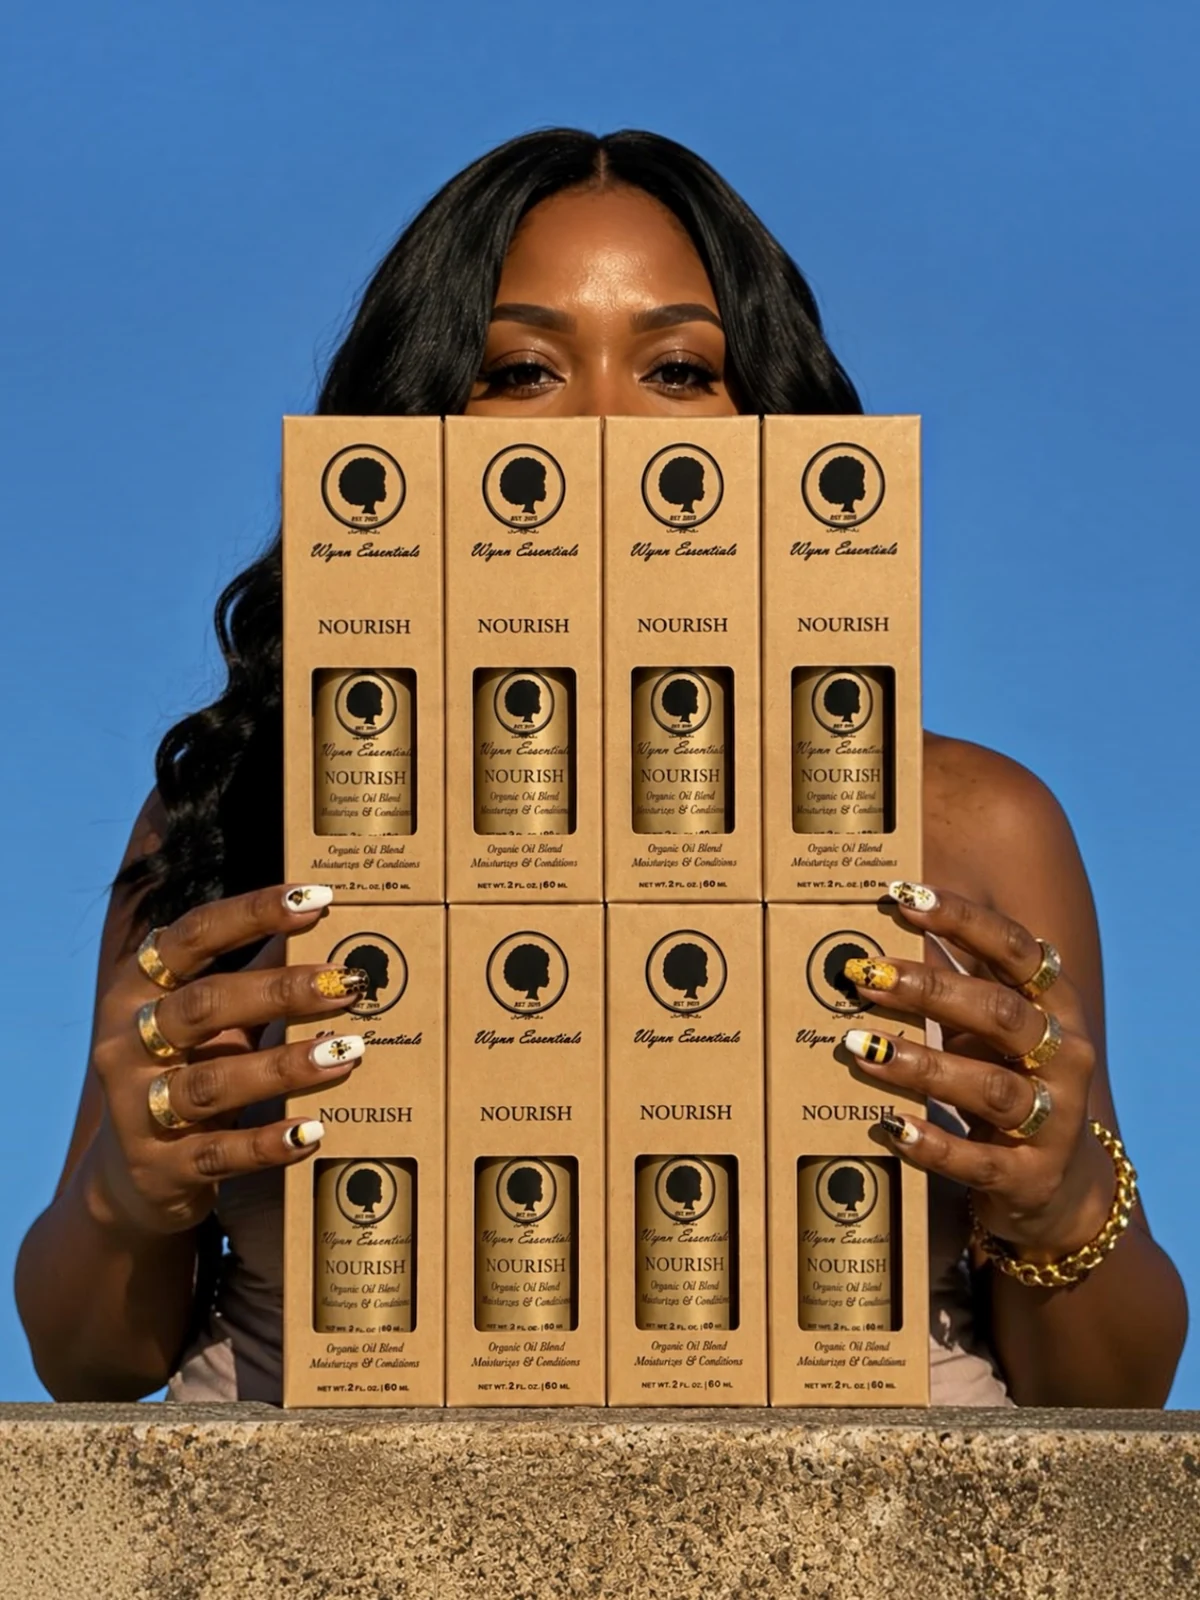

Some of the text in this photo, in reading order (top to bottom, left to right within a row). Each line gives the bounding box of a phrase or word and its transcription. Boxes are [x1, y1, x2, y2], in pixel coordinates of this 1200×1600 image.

[311, 542, 420, 562] Wynn Essentials
[471, 542, 578, 562] Wynn Essentials
[631, 541, 737, 562] Wynn Essentials
[790, 541, 897, 561] Wynn Essentials
[319, 620, 410, 634] NOURISH
[479, 619, 569, 633] NOURISH
[638, 618, 727, 632] NOURISH
[798, 617, 888, 632] NOURISH
[325, 771, 406, 785] NOURISH
[485, 770, 564, 783] NOURISH
[641, 769, 720, 783] NOURISH
[801, 769, 880, 783] NOURISH
[330, 793, 400, 805] Organic Oil Blend
[491, 791, 559, 804] Organic Oil Blend
[647, 791, 715, 803] Organic Oil Blend
[807, 791, 875, 803] Organic Oil Blend
[328, 845, 405, 858] Organic Oil Blend
[487, 844, 563, 857] Organic Oil Blend
[648, 843, 723, 856] Organic Oil Blend
[808, 843, 883, 856] Organic Oil Blend
[363, 859, 374, 870] &
[521, 858, 532, 868] &
[682, 857, 692, 868] &
[842, 857, 852, 868] &
[475, 1030, 581, 1049] Wynn Essentials
[634, 1028, 741, 1048] Wynn Essentials
[796, 1029, 836, 1048] Wynn
[320, 1107, 412, 1123] NOURISH
[481, 1106, 571, 1121] NOURISH
[641, 1105, 731, 1120] NOURISH
[802, 1104, 894, 1121] NOURISH
[325, 1260, 406, 1275] NOURISH
[486, 1259, 566, 1273] NOURISH
[645, 1257, 724, 1272] NOURISH
[807, 1258, 887, 1273] NOURISH
[330, 1283, 400, 1296] Organic Oil Blend
[492, 1282, 560, 1295] Organic Oil Blend
[651, 1280, 719, 1293] Organic Oil Blend
[813, 1281, 882, 1294] Organic Oil Blend
[327, 1342, 404, 1357] Organic Oil Blend
[488, 1341, 565, 1355] Organic Oil Blend
[651, 1341, 728, 1354] Organic Oil Blend
[814, 1341, 890, 1354] Organic Oil Blend
[362, 1358, 373, 1369] &
[523, 1357, 534, 1368] &
[686, 1355, 697, 1367] &
[849, 1356, 860, 1367] &
[348, 1383, 353, 1391] 2
[509, 1382, 514, 1390] 2
[672, 1380, 678, 1388] 2
[835, 1381, 840, 1389] 2
